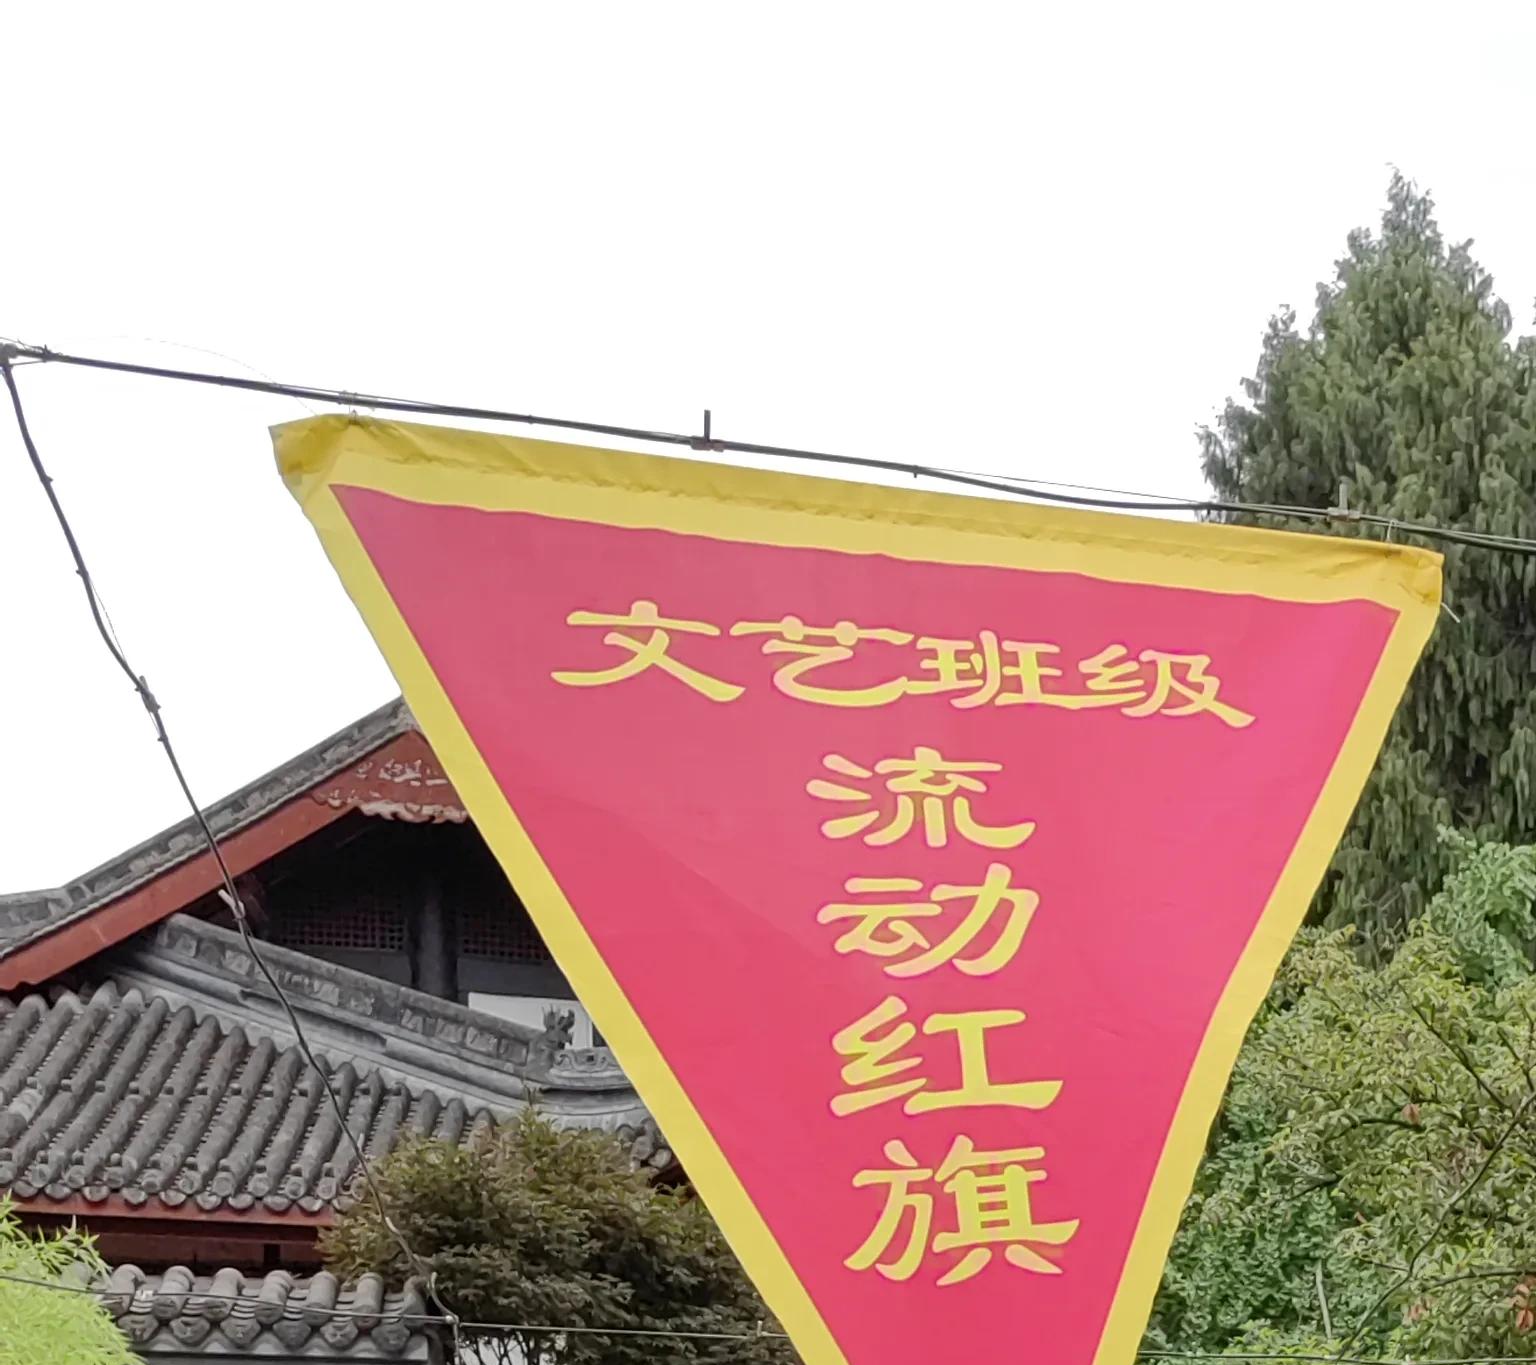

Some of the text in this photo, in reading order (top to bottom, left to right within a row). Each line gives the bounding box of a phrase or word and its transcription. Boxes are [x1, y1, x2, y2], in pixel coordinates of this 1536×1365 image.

[551, 601, 1255, 728] 文艺班级
[806, 747, 1080, 1288] 流动红旗
